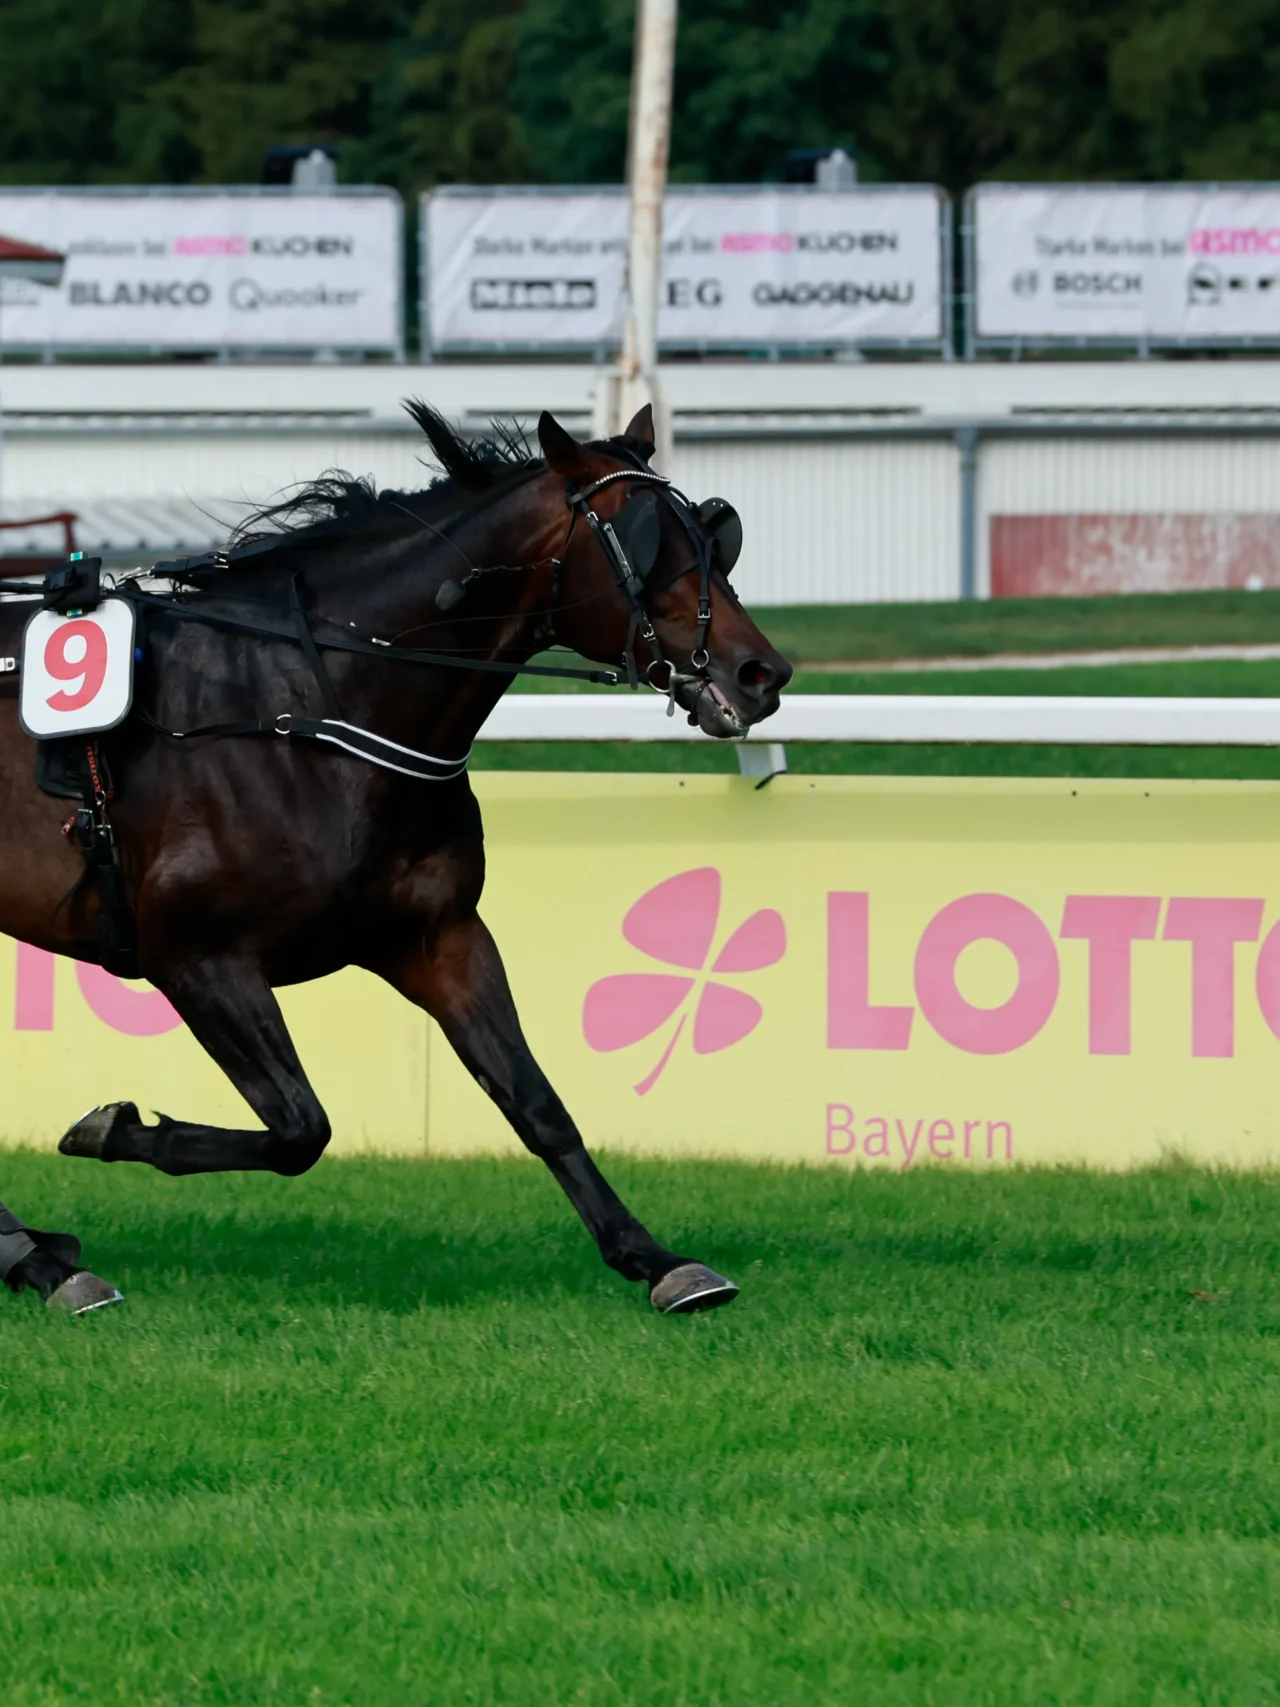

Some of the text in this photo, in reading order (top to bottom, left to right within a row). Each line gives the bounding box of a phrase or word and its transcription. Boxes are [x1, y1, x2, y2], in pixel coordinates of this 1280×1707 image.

[69, 281, 211, 306] BLANCO
[1053, 270, 1143, 294] BOSCH
[44, 619, 108, 712] 9
[826, 891, 1280, 1058] LOTT
[825, 1102, 1014, 1171] Bayern
